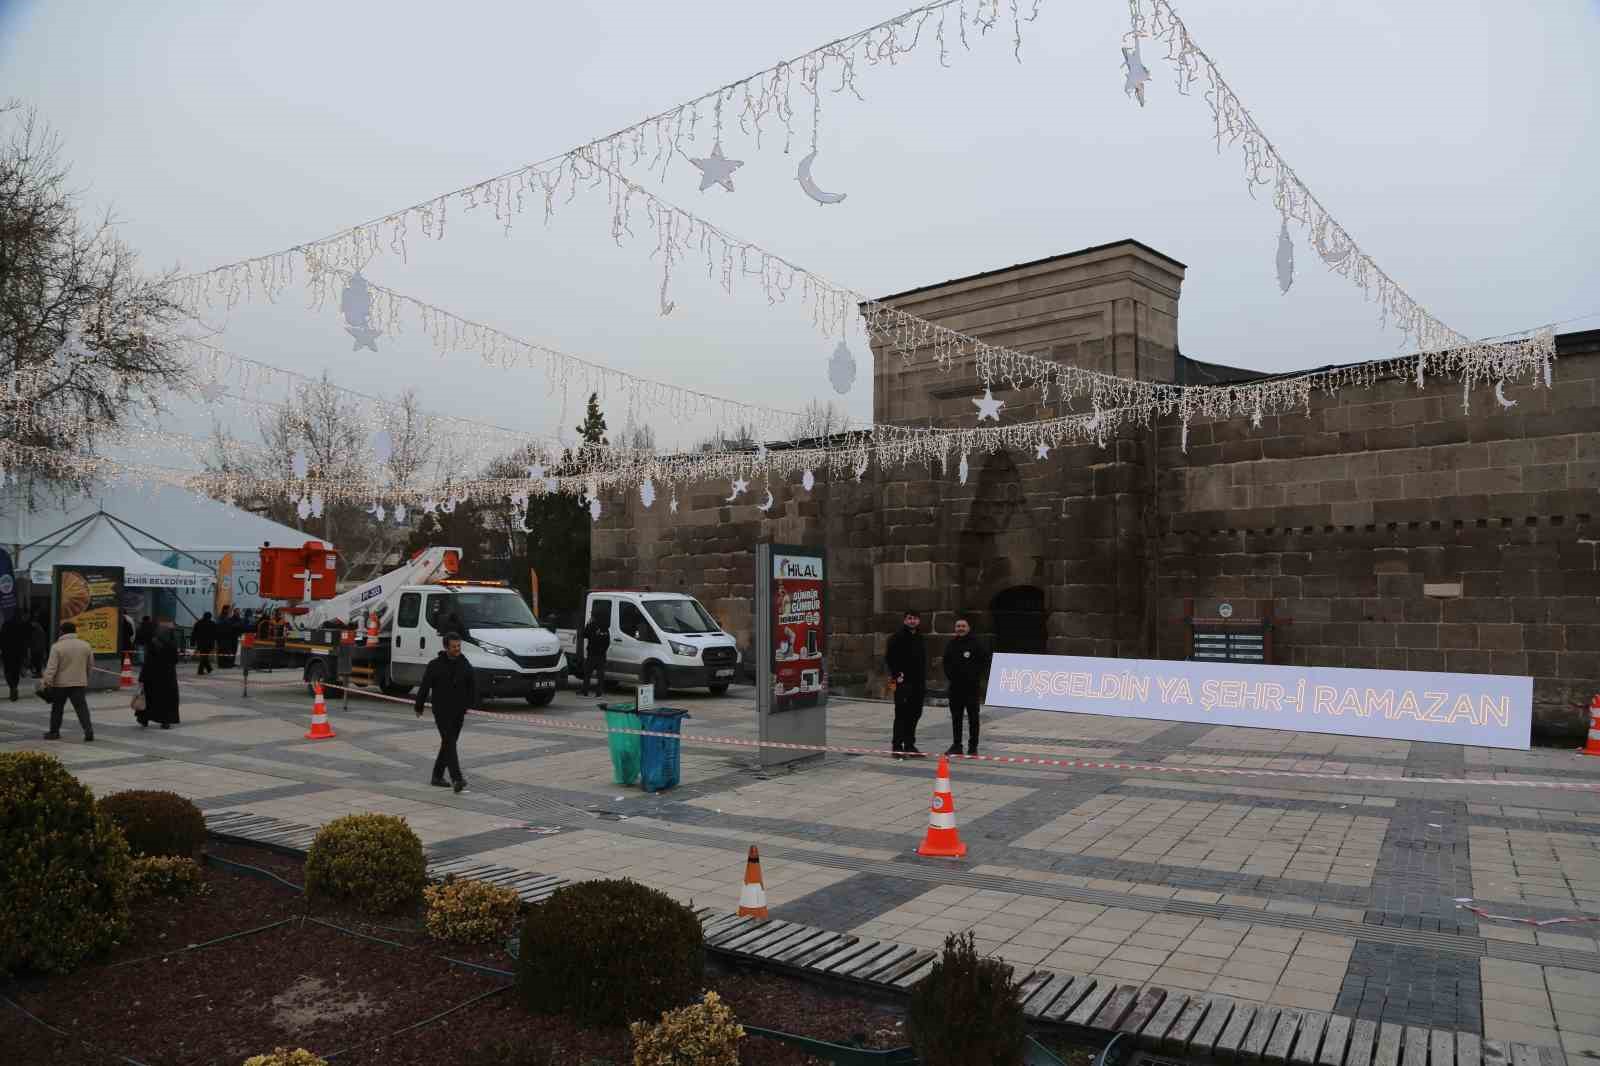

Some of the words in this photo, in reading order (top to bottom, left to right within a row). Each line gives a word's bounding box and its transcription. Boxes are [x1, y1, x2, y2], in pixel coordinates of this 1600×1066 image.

[1000, 668, 1150, 702] HOŞGELDİN
[1157, 676, 1193, 704] YA
[1201, 678, 1305, 712] ŞEHR-İ
[1313, 685, 1510, 727] RAMAZAN
